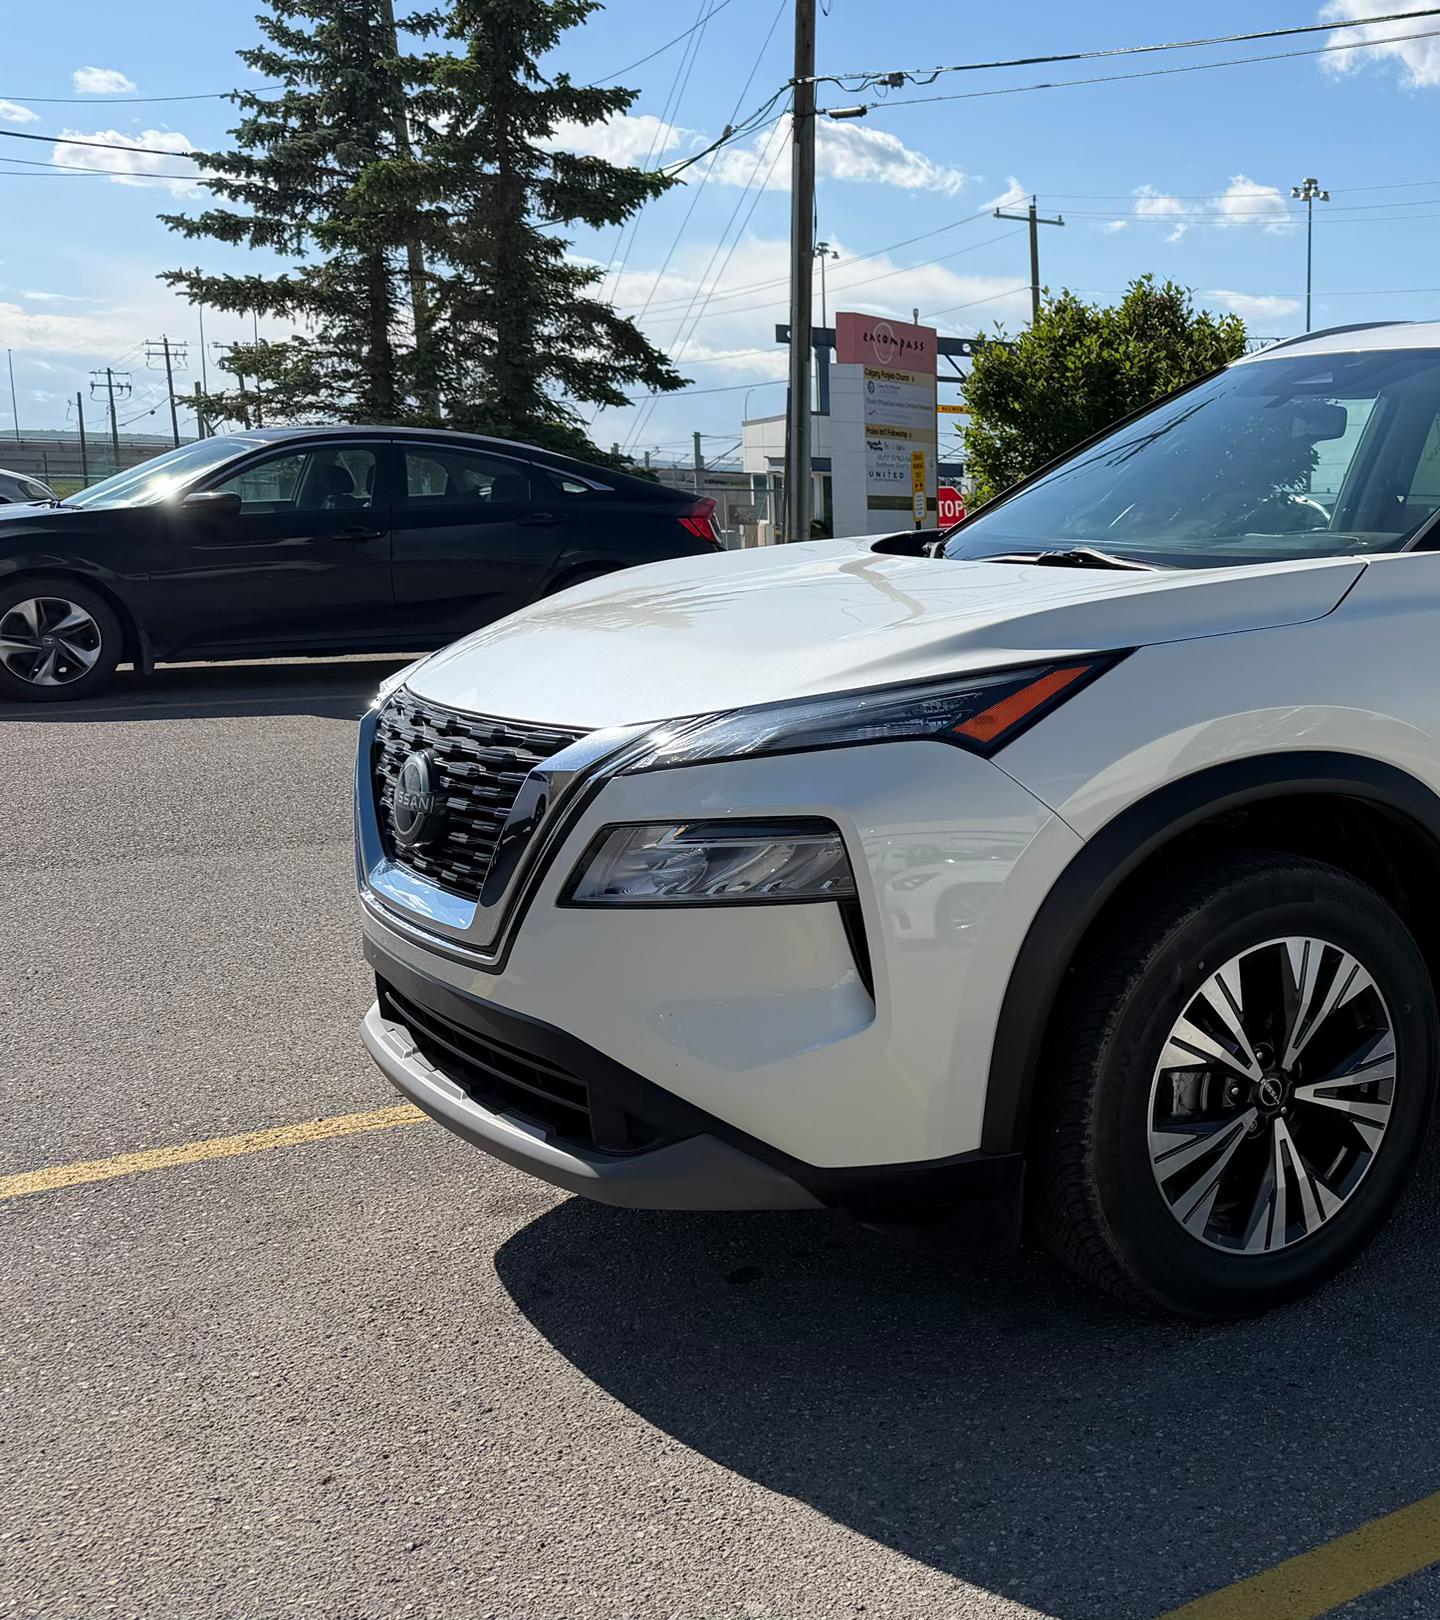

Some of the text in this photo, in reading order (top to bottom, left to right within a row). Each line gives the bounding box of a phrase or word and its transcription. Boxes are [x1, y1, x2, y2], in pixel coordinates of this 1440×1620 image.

[863, 332, 924, 356] encompass
[868, 471, 904, 479] UNITED
[939, 500, 963, 518] TOP
[397, 791, 430, 810] SSAN
